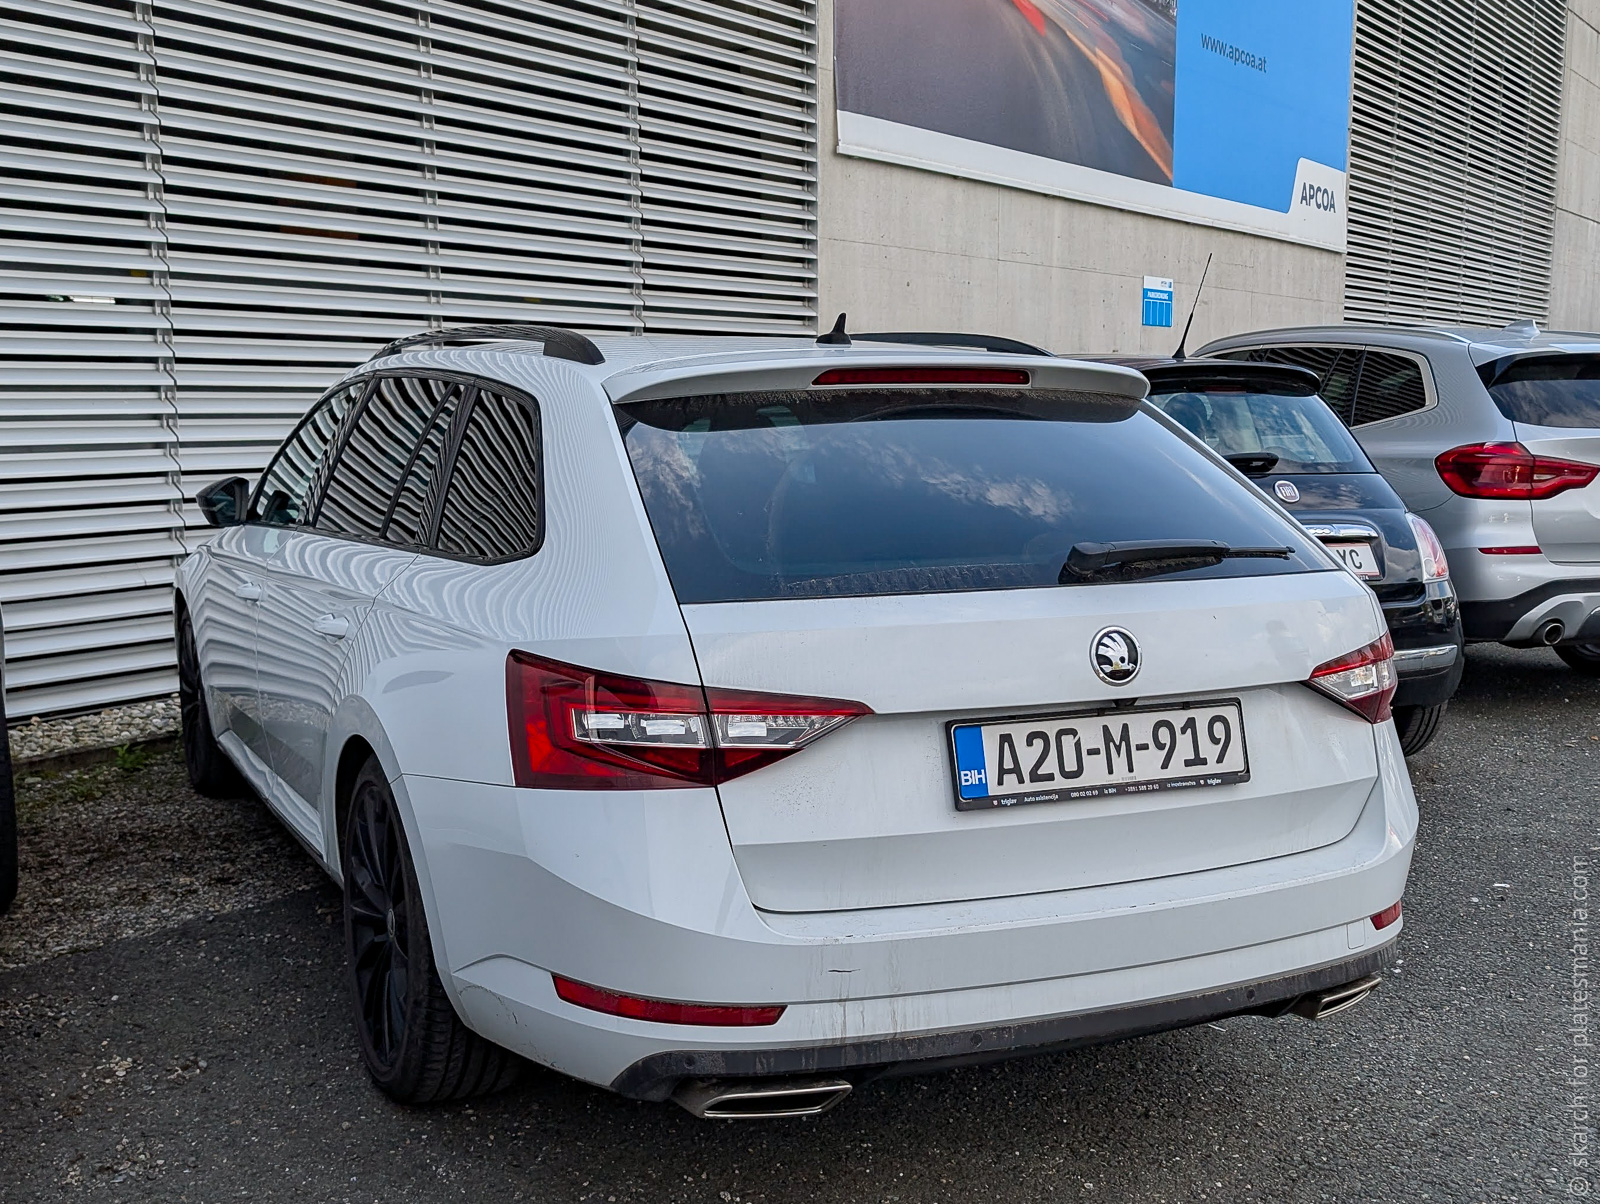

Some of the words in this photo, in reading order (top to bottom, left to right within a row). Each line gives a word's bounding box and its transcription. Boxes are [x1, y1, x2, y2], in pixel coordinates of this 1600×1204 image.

[1201, 33, 1267, 73] www.apcoa.at
[1300, 181, 1336, 214] APCOA
[997, 714, 1232, 786] A20-M-919
[960, 769, 986, 786] BIH
